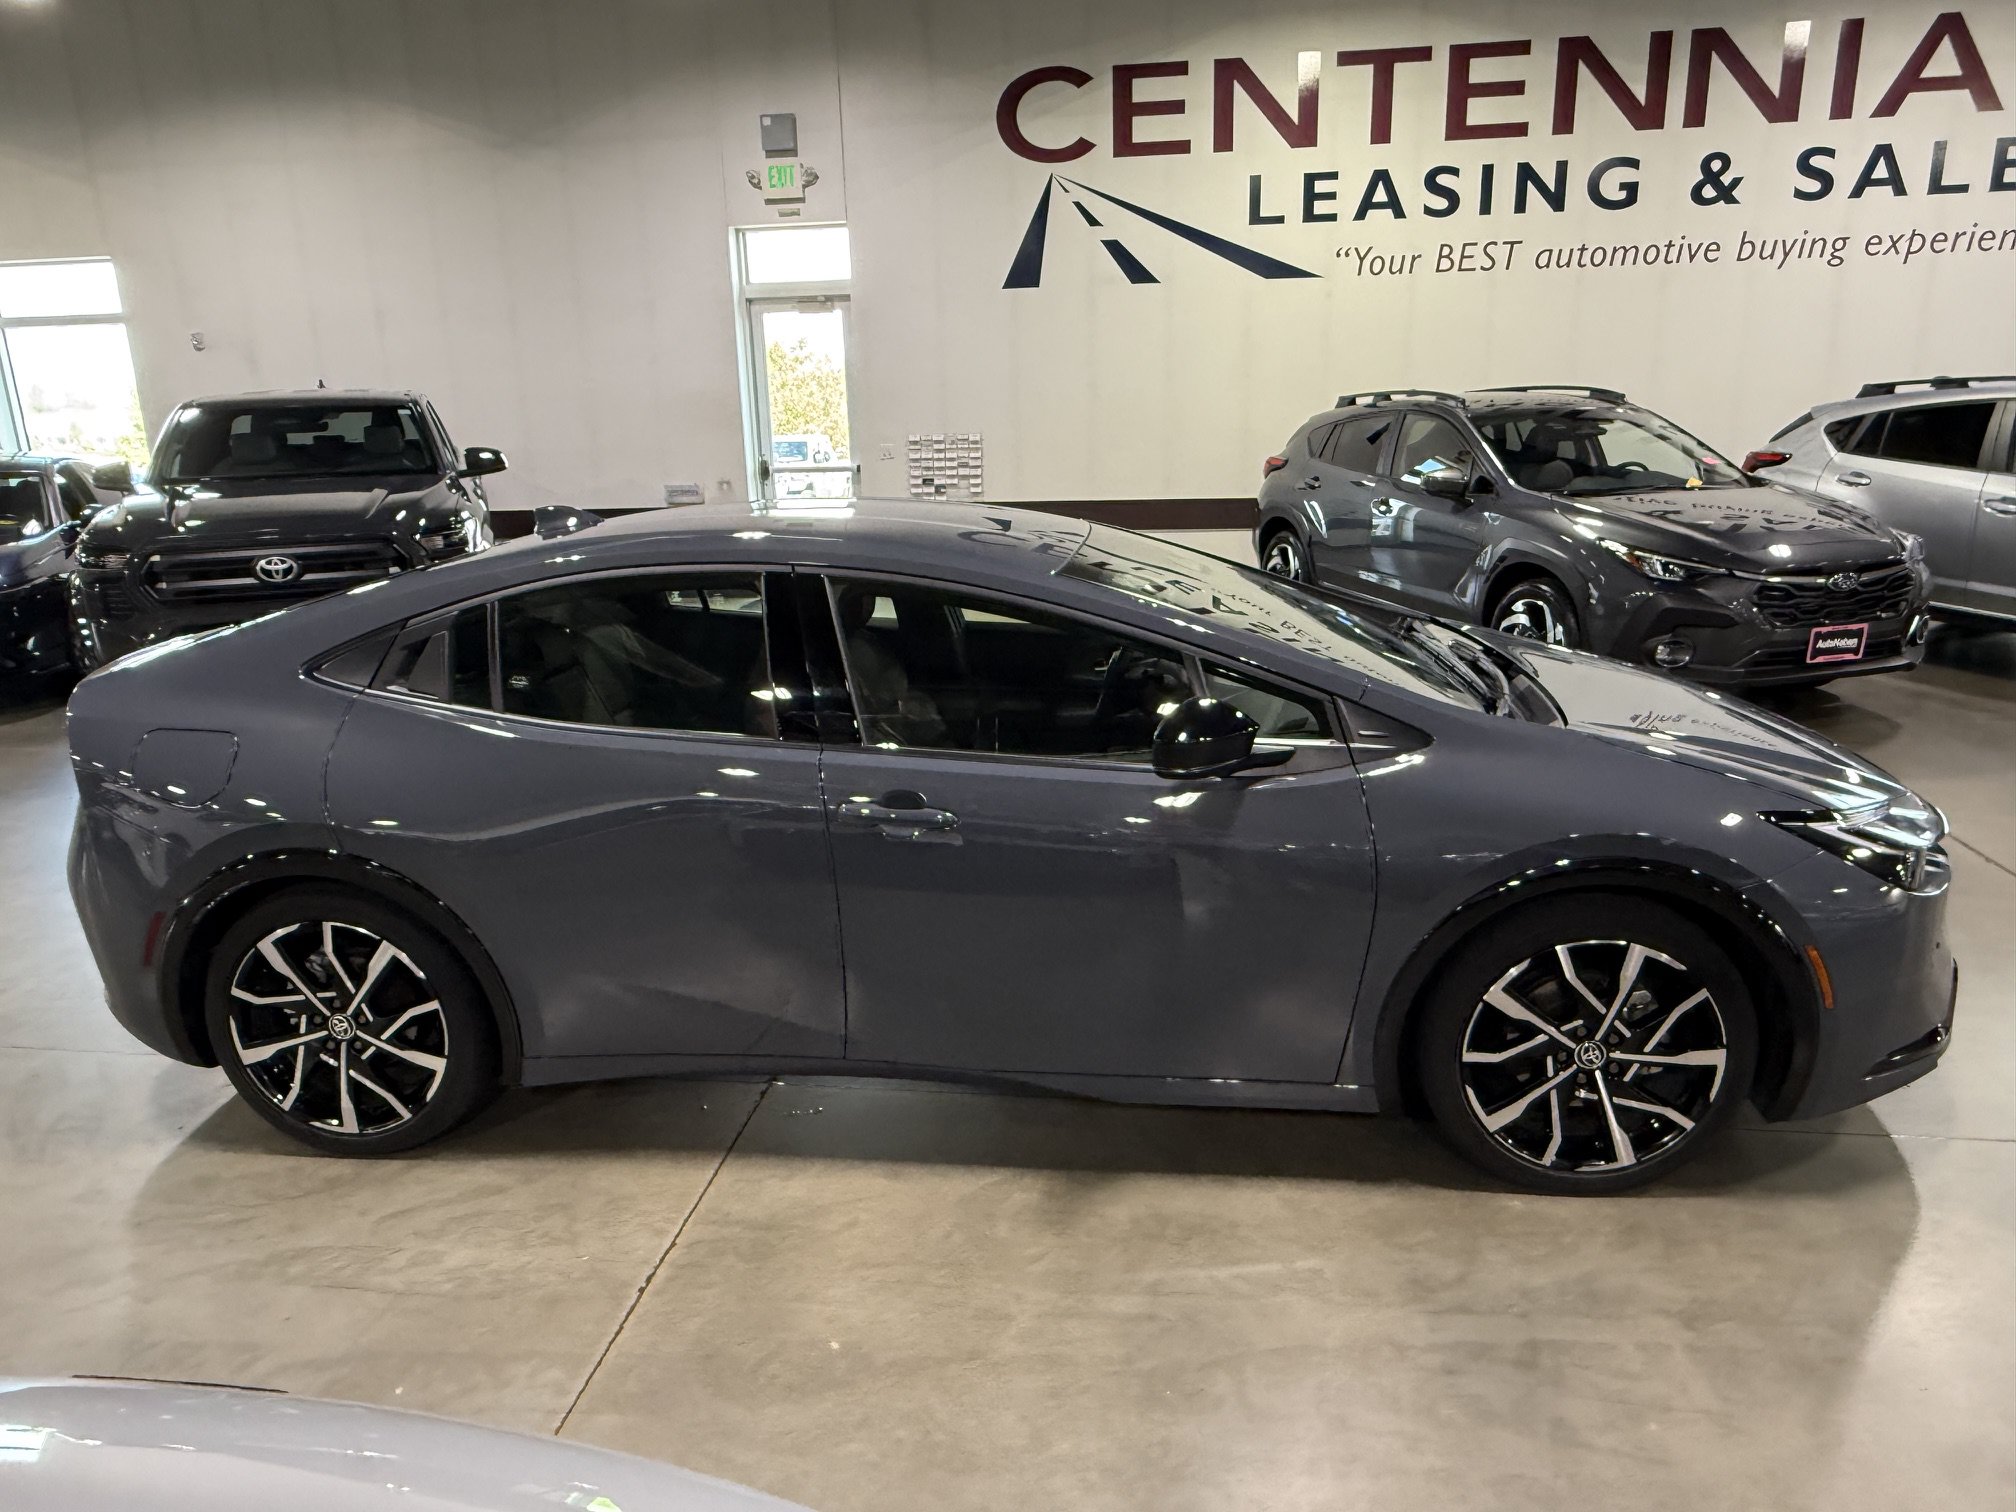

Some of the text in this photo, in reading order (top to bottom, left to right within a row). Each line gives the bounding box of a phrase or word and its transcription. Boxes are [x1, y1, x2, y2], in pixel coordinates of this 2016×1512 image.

[996, 11, 2005, 163] CENTENNIA
[768, 165, 795, 188] EXIT
[1249, 157, 1641, 226] LEASING
[1690, 152, 1744, 206] &
[1335, 246, 1422, 276] “Your
[1435, 241, 1523, 273] BEST
[1534, 235, 1720, 270] automotive
[1736, 230, 1850, 270] buying
